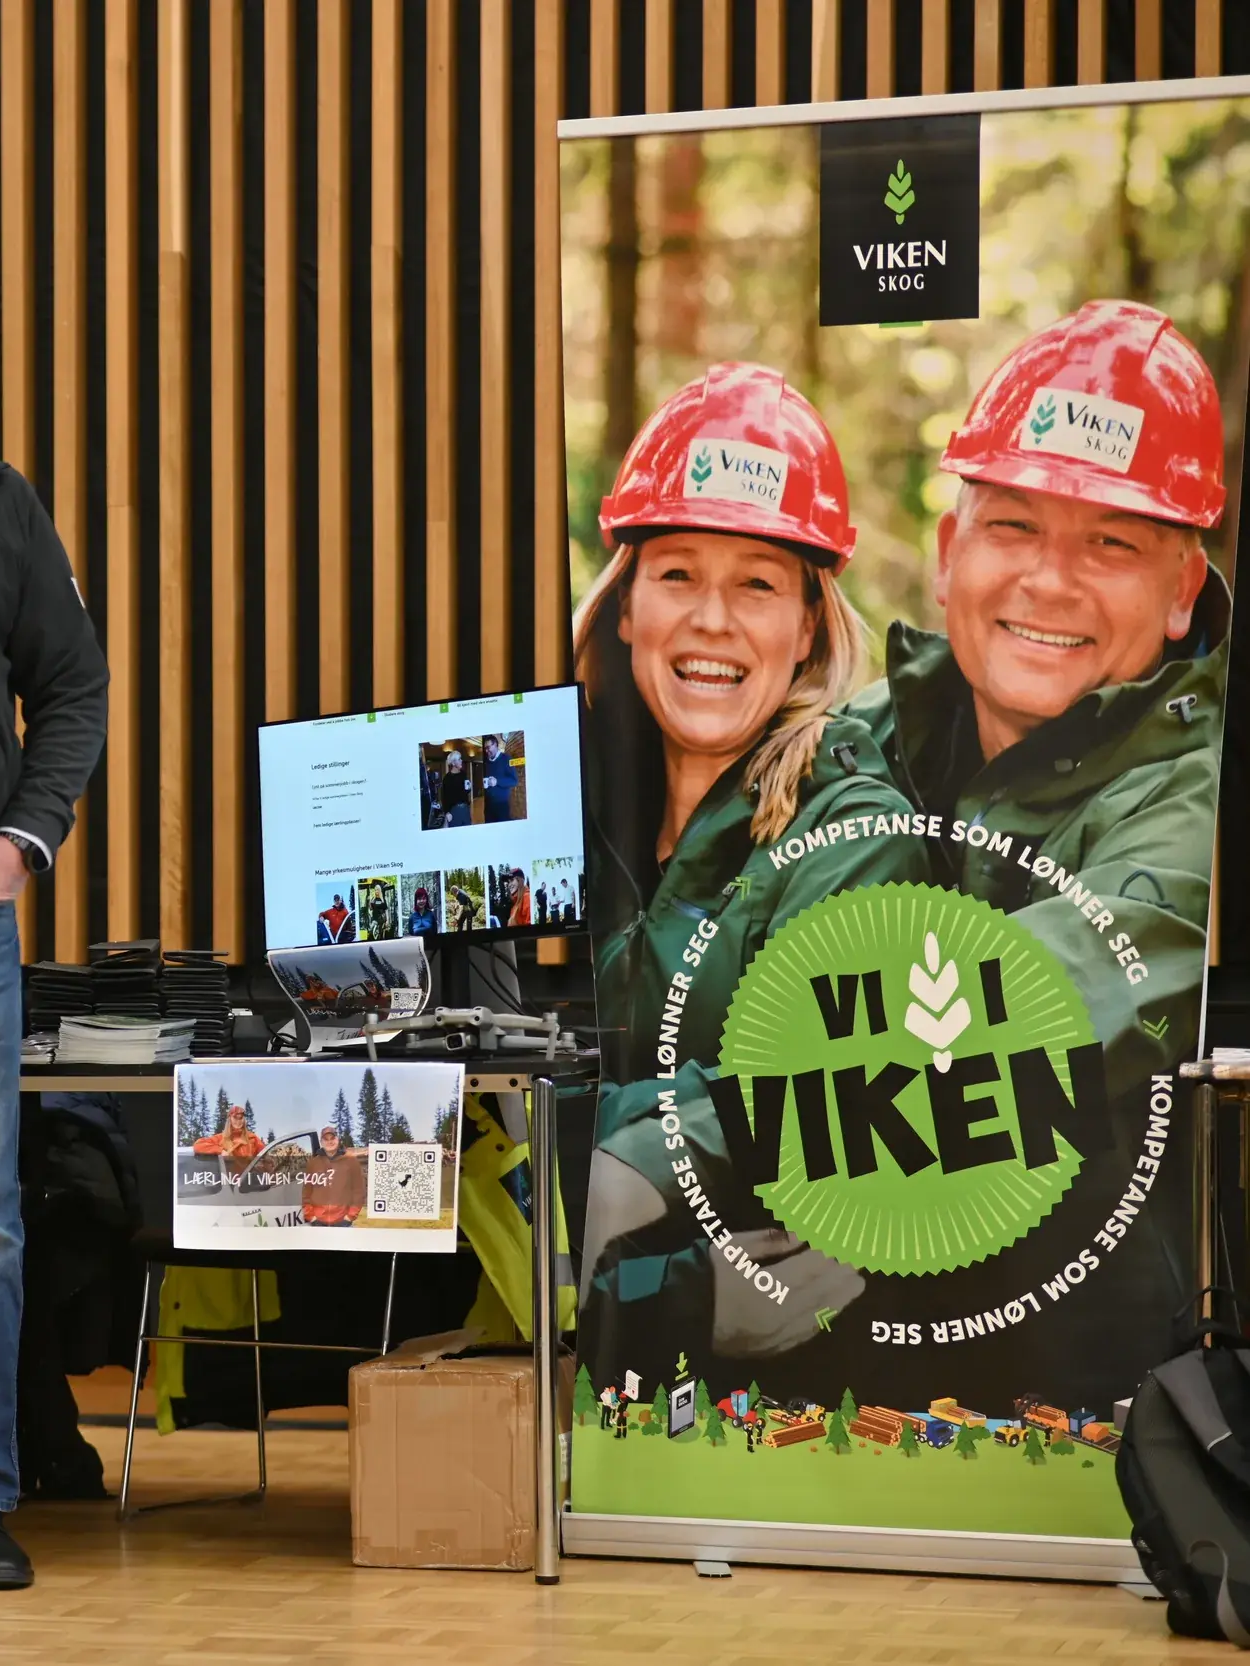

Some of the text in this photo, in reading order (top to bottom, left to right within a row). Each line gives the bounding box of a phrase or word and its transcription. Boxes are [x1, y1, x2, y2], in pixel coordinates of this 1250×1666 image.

[852, 240, 946, 270] VIKEN
[878, 273, 924, 292] SKOG
[1067, 401, 1134, 441] VIKEN
[719, 448, 782, 484] VIKEN
[1085, 436, 1128, 460] SKOG
[741, 479, 778, 501] SKOG
[768, 813, 1148, 985] KOMPETANSE SOM LØNNER SEG
[809, 957, 1009, 1041] VI I
[657, 917, 790, 1305] KOMPETANSE SOM LØNNER SEG
[707, 1041, 1114, 1185] VIKEN
[184, 1170, 241, 1187] LÆRLING
[257, 1170, 291, 1185] VIKEN
[295, 1169, 336, 1187] SKOG?
[871, 1074, 1173, 1345] KOMPETANSE SOM LØNNER SEG
